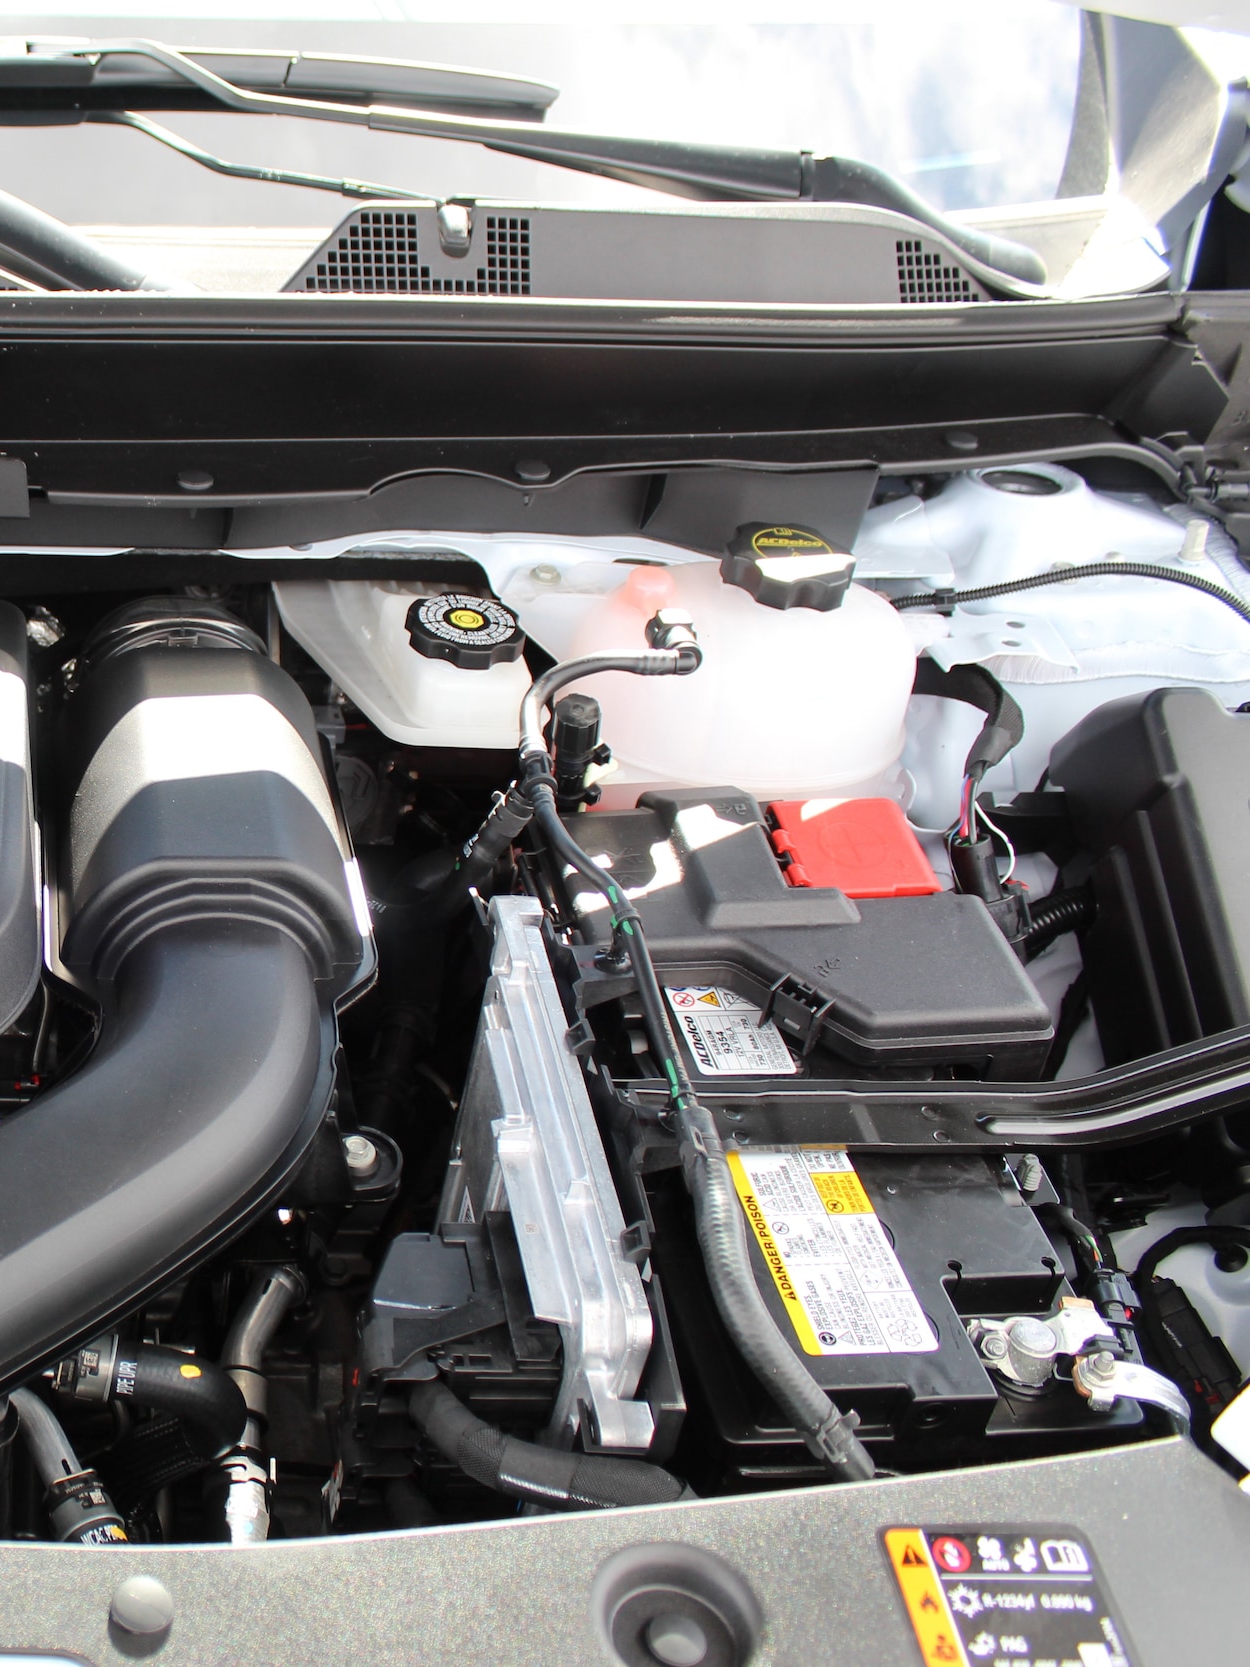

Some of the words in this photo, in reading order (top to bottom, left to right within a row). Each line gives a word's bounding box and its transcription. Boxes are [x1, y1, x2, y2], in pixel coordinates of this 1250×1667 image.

[756, 537, 824, 548] ACDelco
[740, 1018, 749, 1029] 730
[683, 1016, 713, 1067] ACDelco
[715, 1031, 733, 1053] 9354
[725, 1027, 738, 1044] VRLA
[733, 1046, 744, 1057] 12V
[756, 1054, 766, 1065] 730
[750, 1172, 766, 1195] SULFURIC
[763, 1184, 774, 1195] ACID
[743, 1195, 793, 1290] DANGER/POISON
[805, 1280, 819, 1298] GASES
[814, 1299, 833, 1329] EXPLOSIVE
[842, 1305, 853, 1315] LES
[845, 1292, 864, 1321] EXPLOSIFS
[810, 1310, 825, 1329] SHIELD
[859, 1322, 871, 1334] GAZ
[864, 1335, 876, 1345] LES
[117, 1361, 138, 1379] UPR
[1000, 1636, 1028, 1653] PAG
